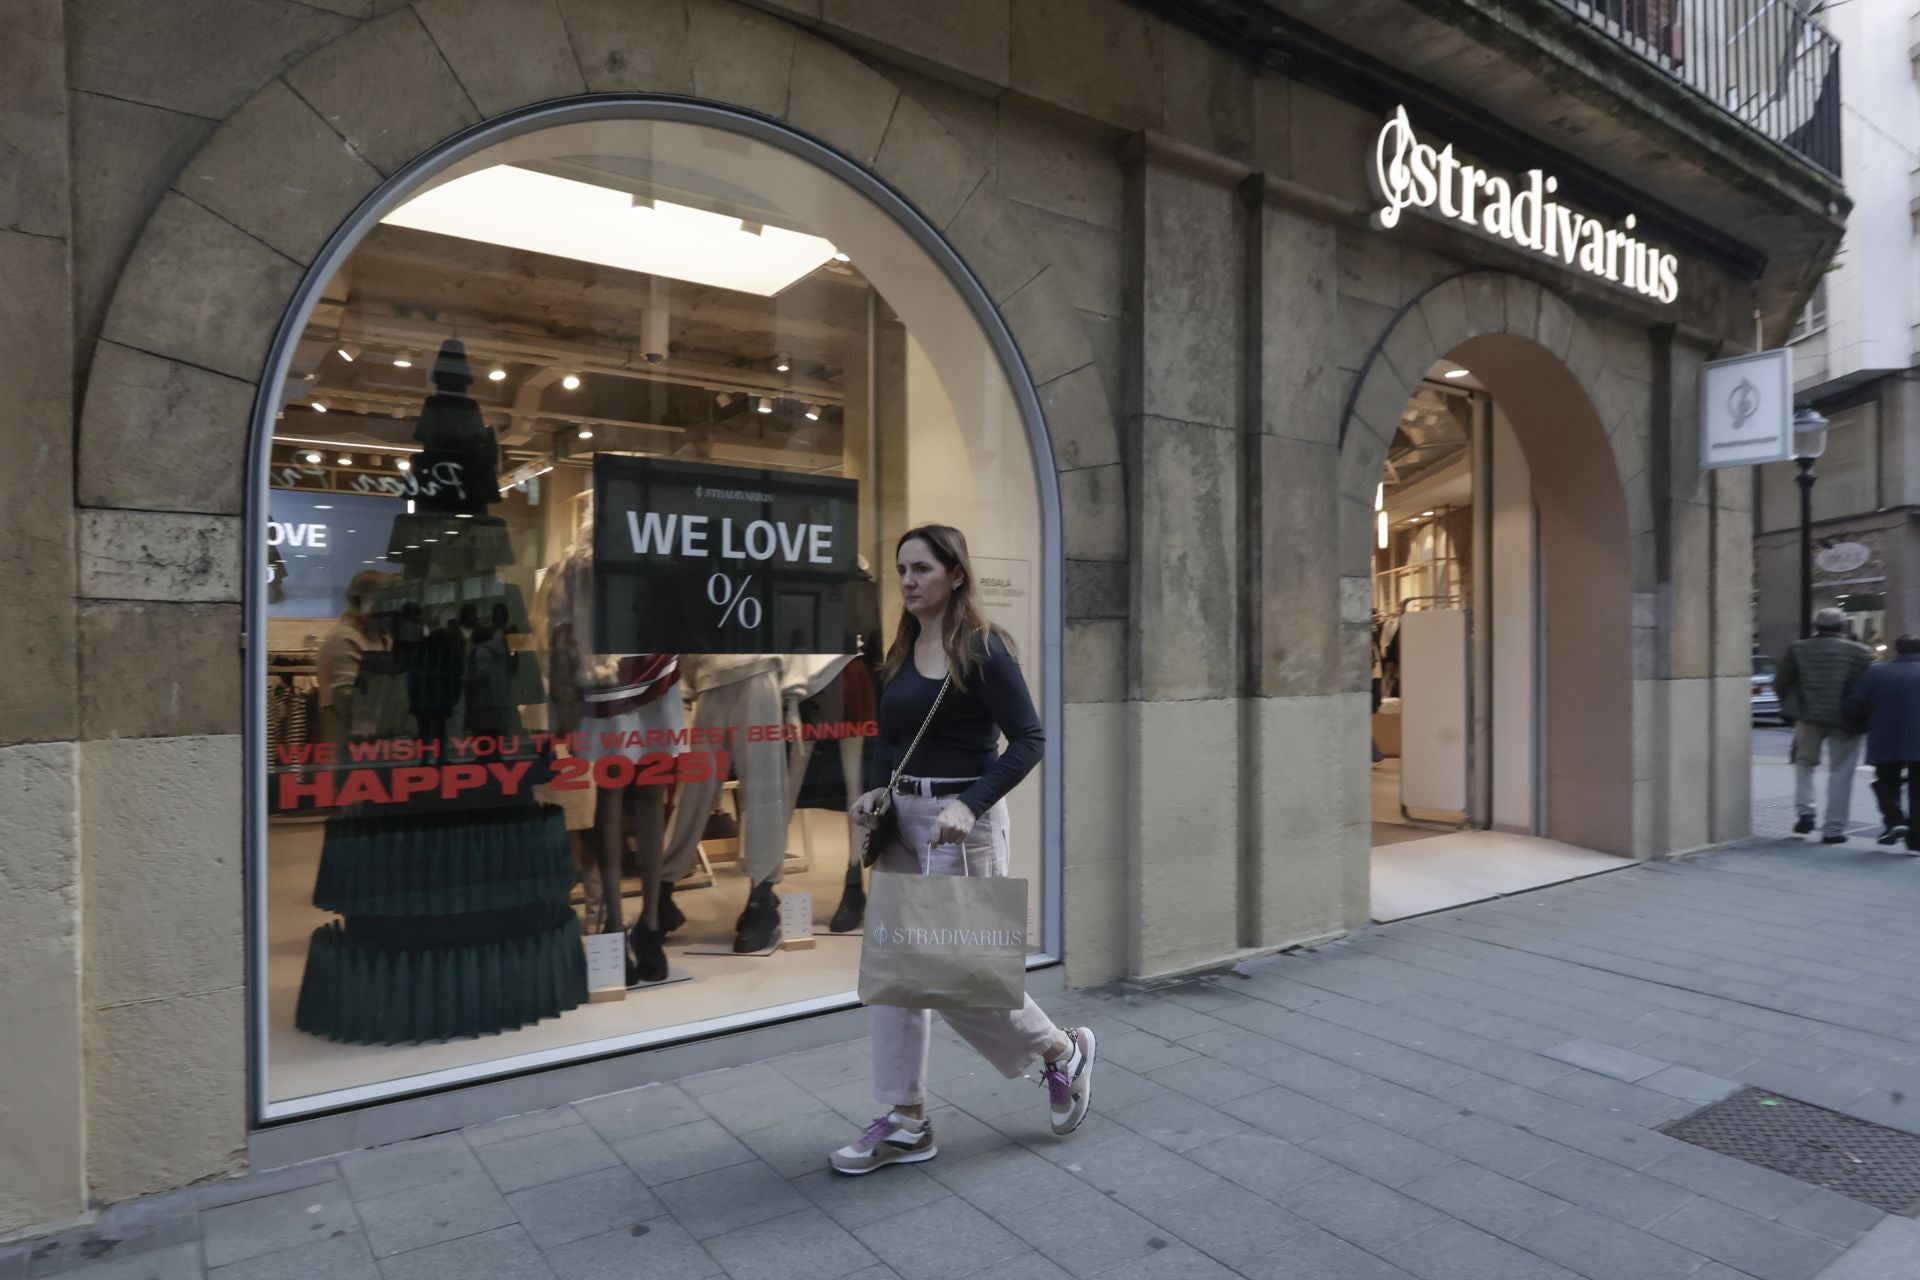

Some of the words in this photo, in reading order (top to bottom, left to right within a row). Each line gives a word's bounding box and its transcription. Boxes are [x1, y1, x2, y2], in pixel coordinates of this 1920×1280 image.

[626, 510, 709, 558] WE
[721, 517, 833, 564] LOVE
[706, 572, 763, 629] %
[277, 742, 337, 765] WE
[347, 738, 441, 762] WISH
[450, 735, 521, 757] YOU
[535, 731, 592, 753] THE
[600, 726, 740, 751] WARMEST
[747, 720, 880, 743] BEGINNING
[278, 760, 534, 810] HAPPY
[549, 749, 730, 792] 2025!
[892, 927, 1022, 947] STRADIVARIUS
